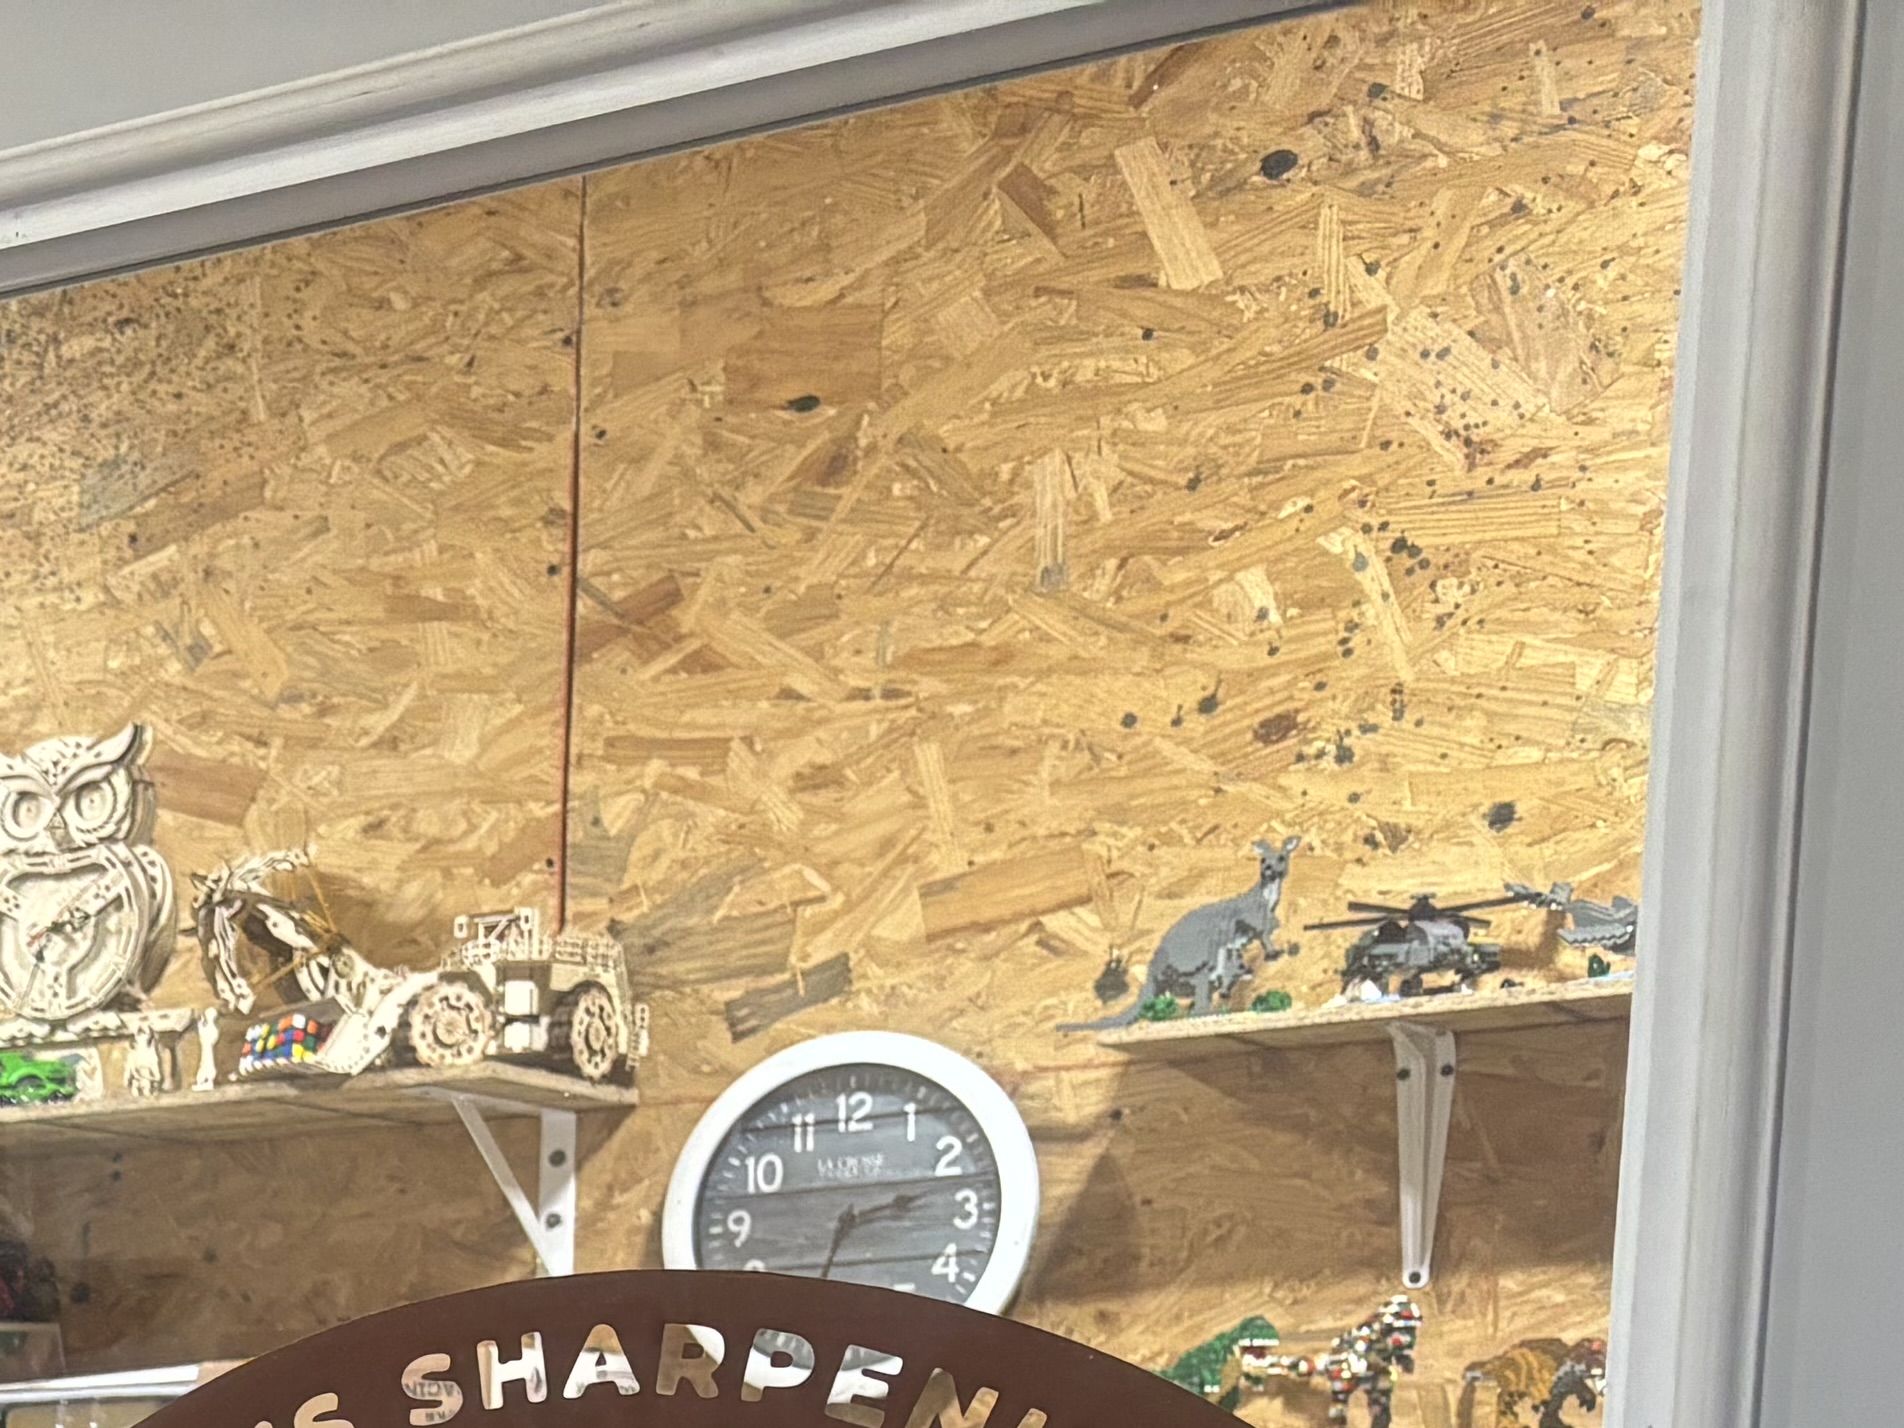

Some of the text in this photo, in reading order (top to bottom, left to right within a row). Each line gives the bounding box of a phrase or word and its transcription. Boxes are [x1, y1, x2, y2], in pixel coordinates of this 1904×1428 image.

[837, 1092, 873, 1132] 12
[904, 1102, 916, 1141] 1
[746, 1154, 783, 1194] 10
[934, 1136, 962, 1177] 2
[727, 1210, 751, 1248] 9
[953, 1189, 978, 1230] 3
[931, 1243, 959, 1282] 4
